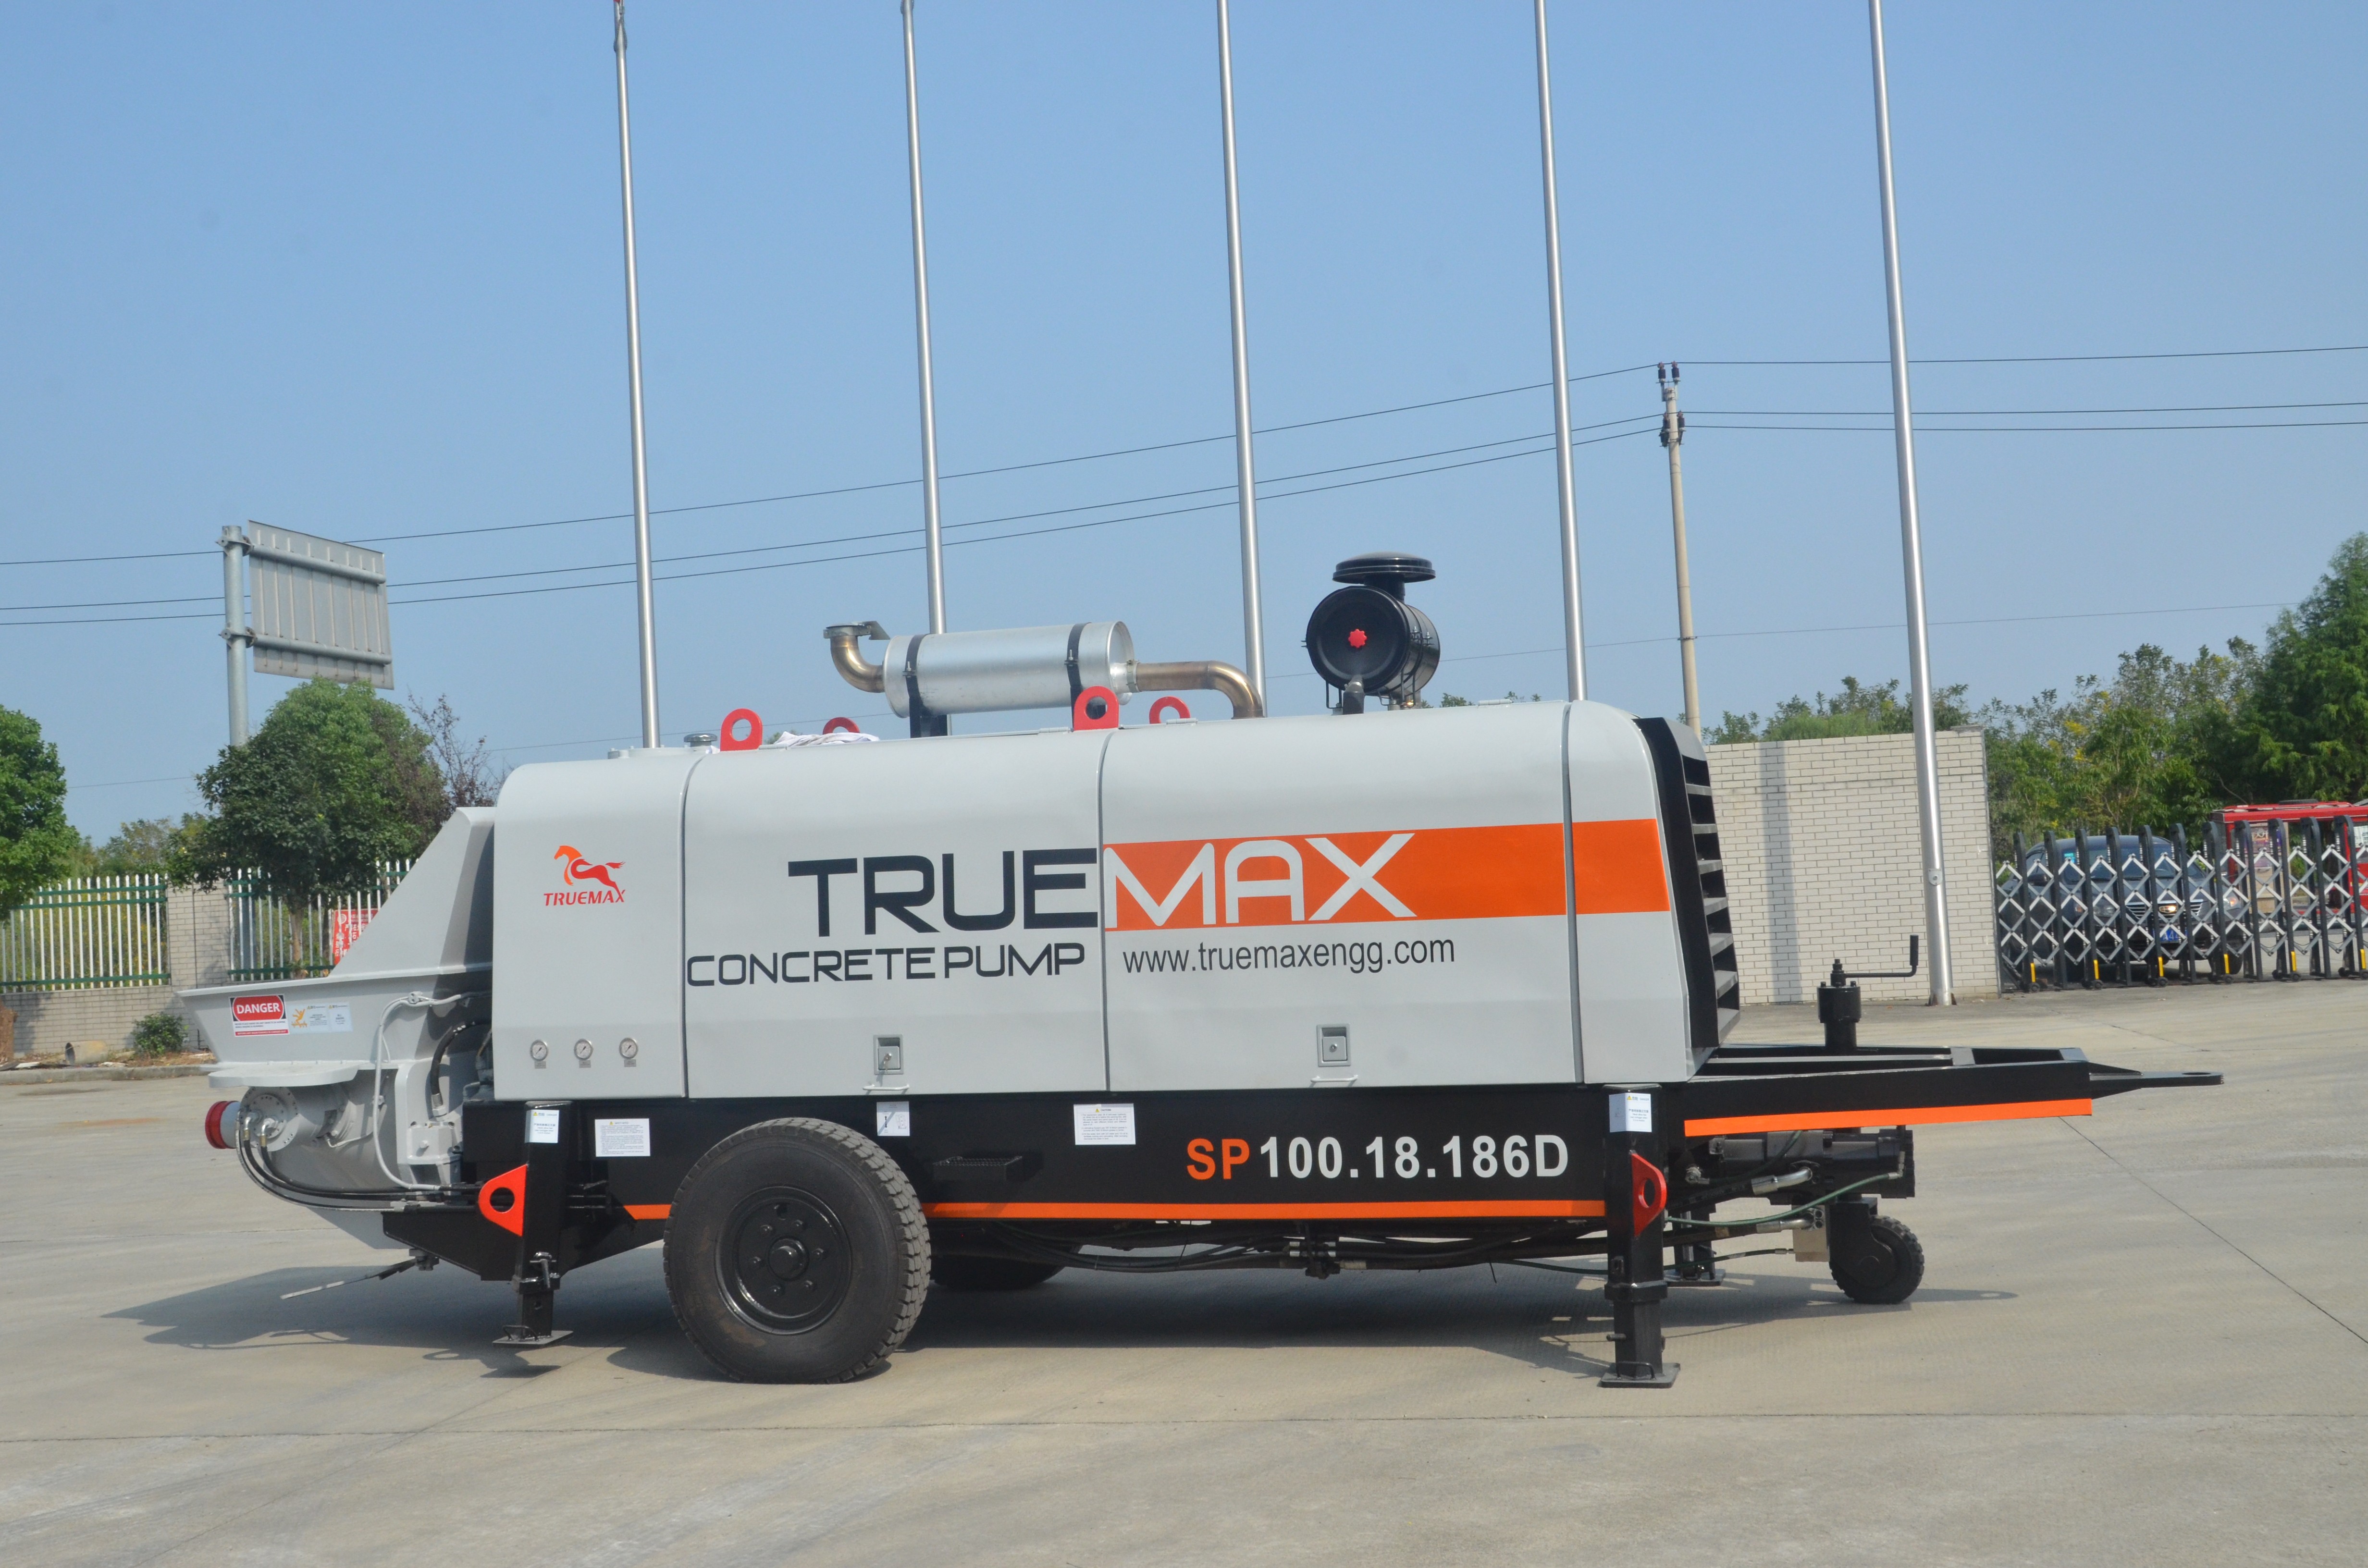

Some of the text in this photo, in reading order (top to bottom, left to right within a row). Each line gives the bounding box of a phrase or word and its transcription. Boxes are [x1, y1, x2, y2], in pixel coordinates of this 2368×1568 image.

[544, 890, 625, 906] TRUEMAX
[1122, 939, 1455, 974] www.truemaxengg.com
[236, 1003, 281, 1014] DANGER
